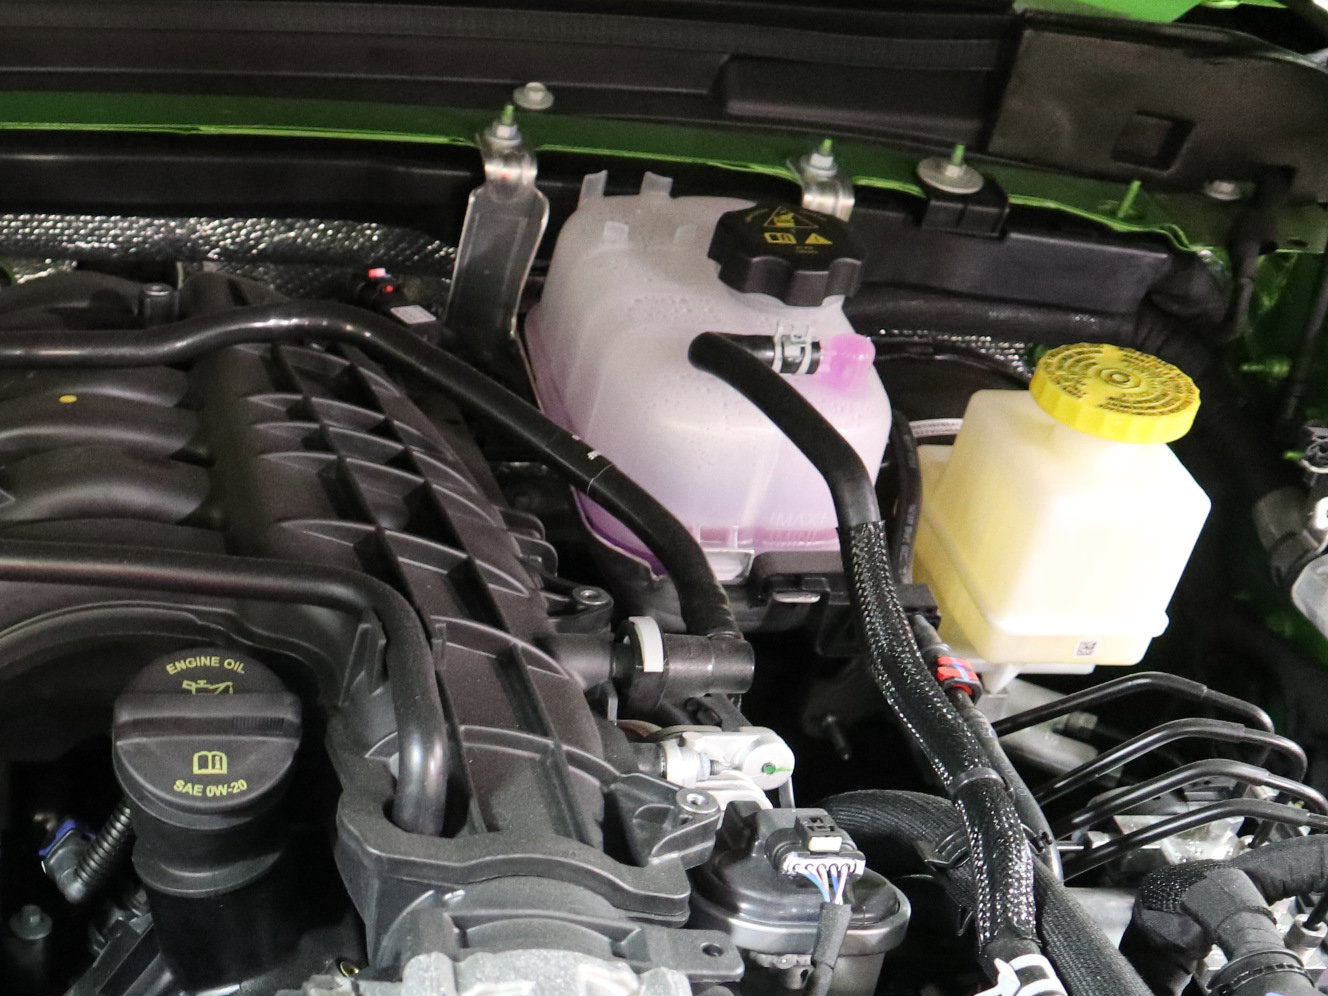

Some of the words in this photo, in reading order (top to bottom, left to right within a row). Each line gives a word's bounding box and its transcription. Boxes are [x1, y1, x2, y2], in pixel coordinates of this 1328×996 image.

[165, 655, 221, 675] ENGINE
[223, 658, 246, 674] OIL
[173, 779, 204, 797] SAE
[206, 779, 248, 797] 0W-20
